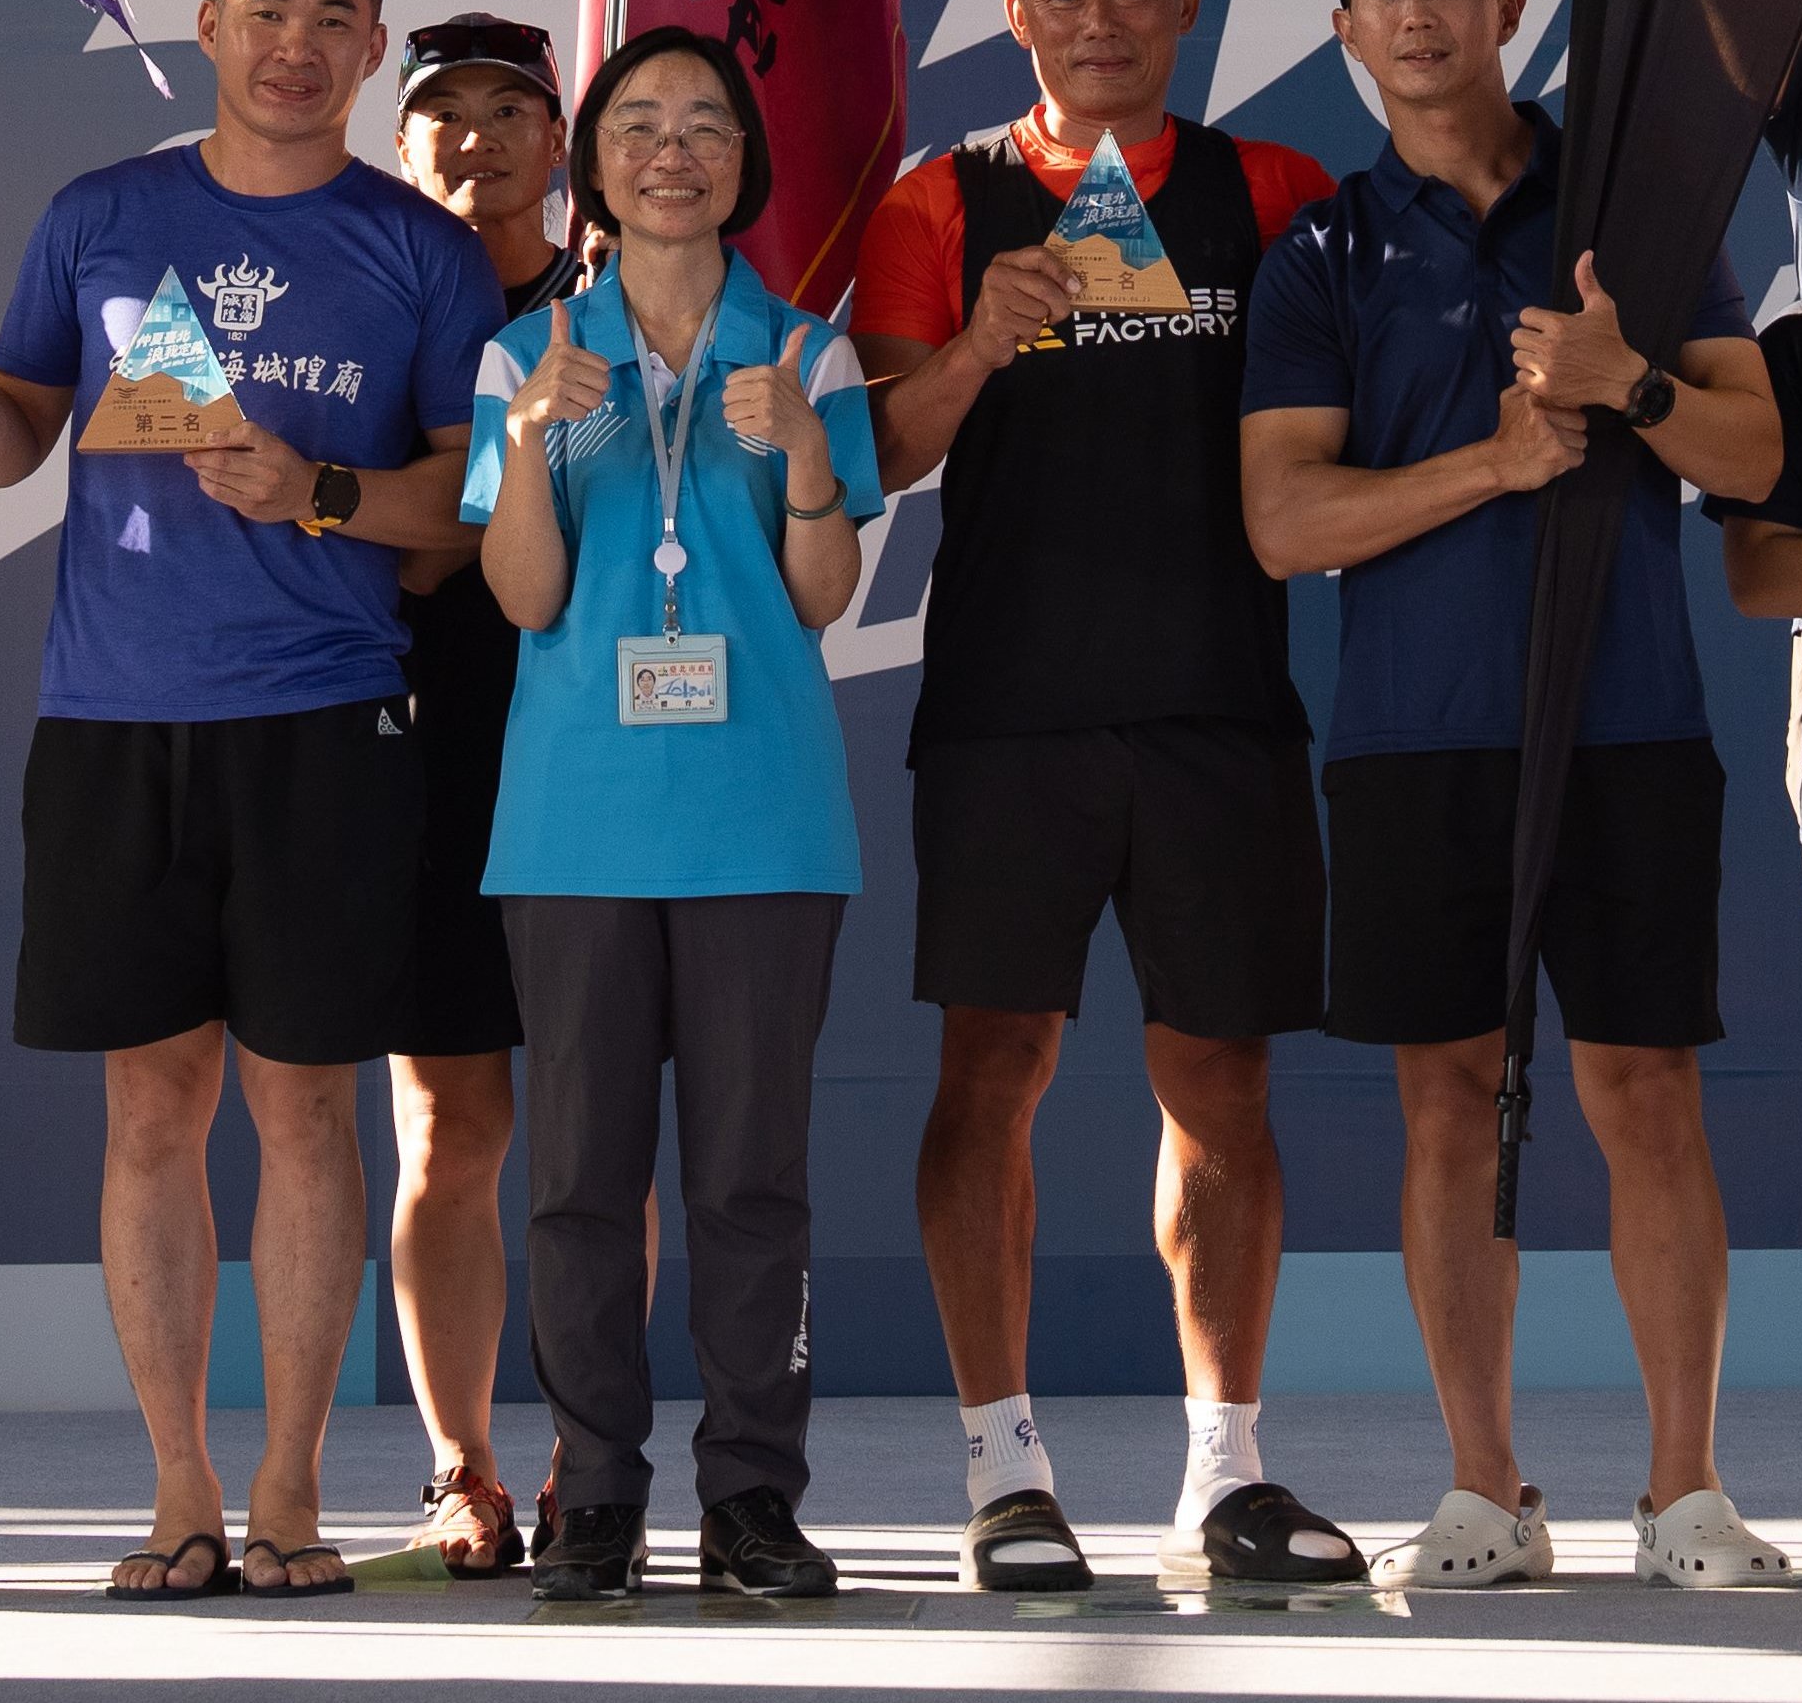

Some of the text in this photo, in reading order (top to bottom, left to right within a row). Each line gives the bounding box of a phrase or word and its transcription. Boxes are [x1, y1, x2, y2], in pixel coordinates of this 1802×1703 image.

[227, 331, 247, 342] 1821
[1075, 312, 1238, 346] FACTORY
[135, 412, 201, 434] 第二名
